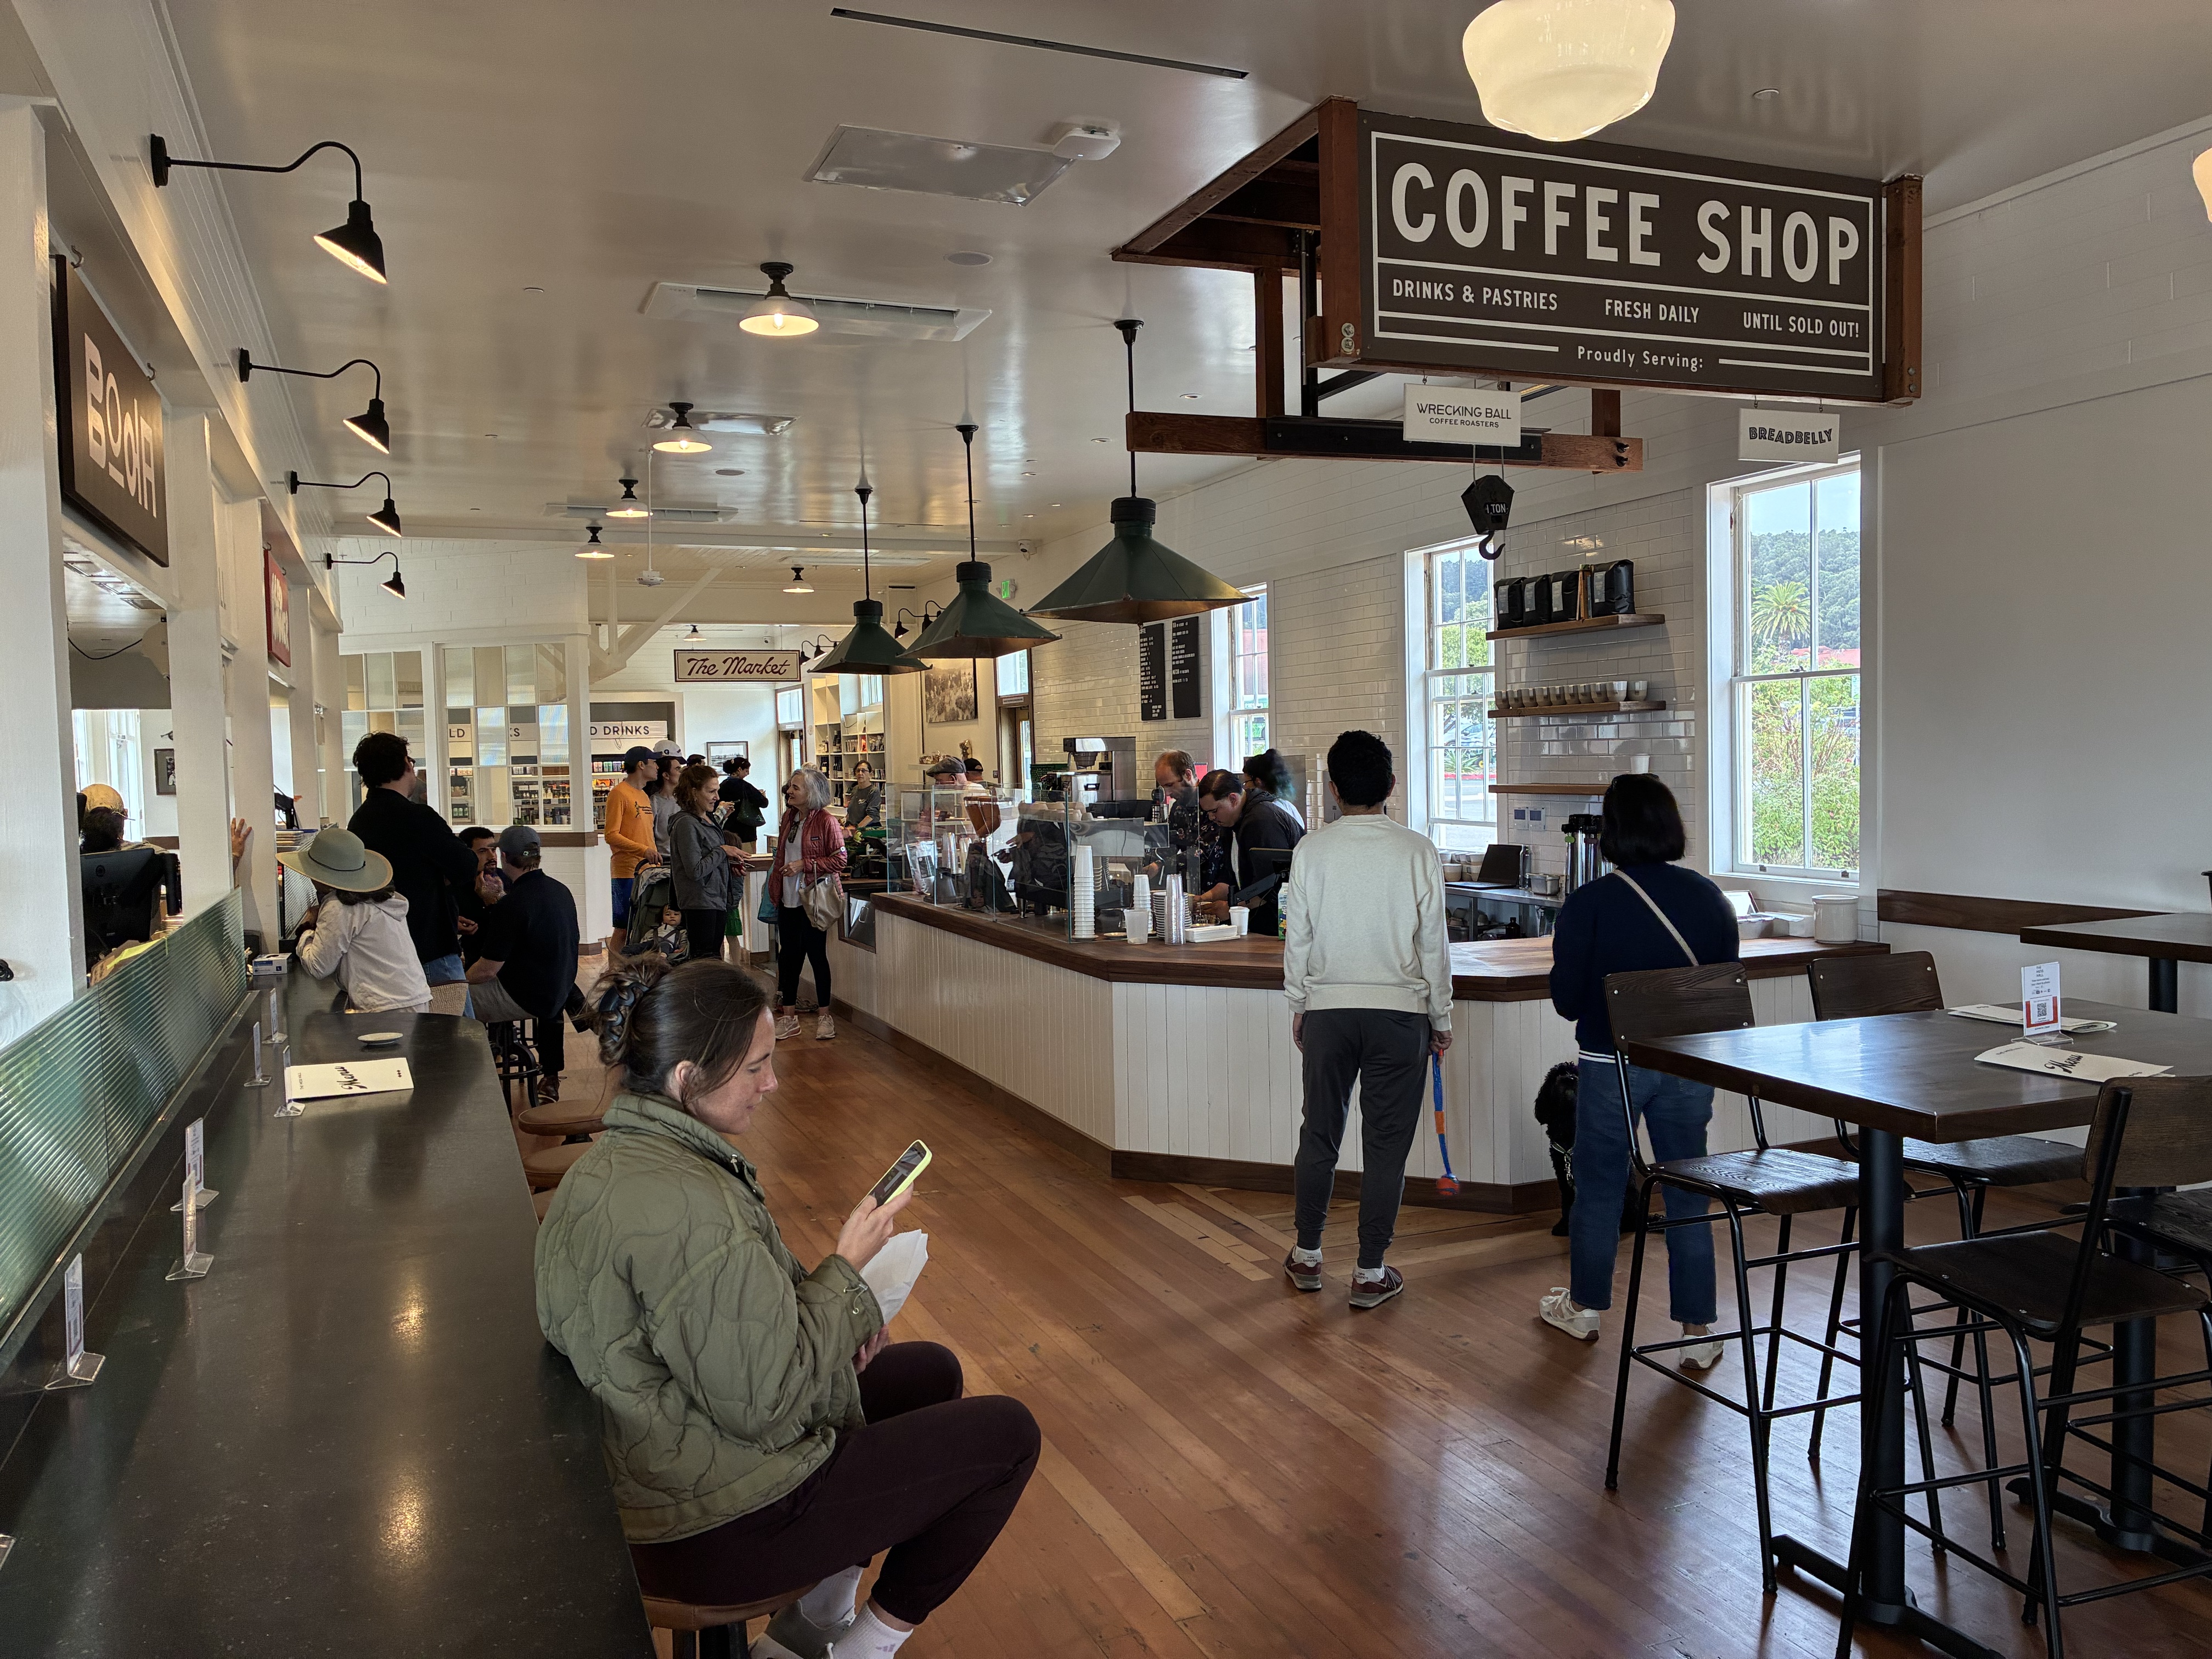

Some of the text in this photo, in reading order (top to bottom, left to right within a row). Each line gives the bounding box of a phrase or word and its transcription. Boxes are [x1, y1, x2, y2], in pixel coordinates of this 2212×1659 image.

[1392, 162, 1859, 285] COFFEE SHOP
[1393, 278, 1558, 311] DRINKS & PASTRIES
[1605, 299, 1699, 323] FRESH DAILY
[1743, 312, 1859, 338] UNTIL SOLD OUT!
[1578, 345, 1703, 372] Proudly Serving:
[1416, 402, 1512, 420] WRECKING BALL
[1460, 419, 1499, 428] ROASTERS
[1749, 426, 1832, 445] BREADBELLY
[1490, 503, 1506, 513] TON
[686, 656, 791, 676] The Market
[603, 726, 650, 735] DRINKS
[2044, 1054, 2084, 1074] Menu
[334, 1066, 368, 1090] Menu
